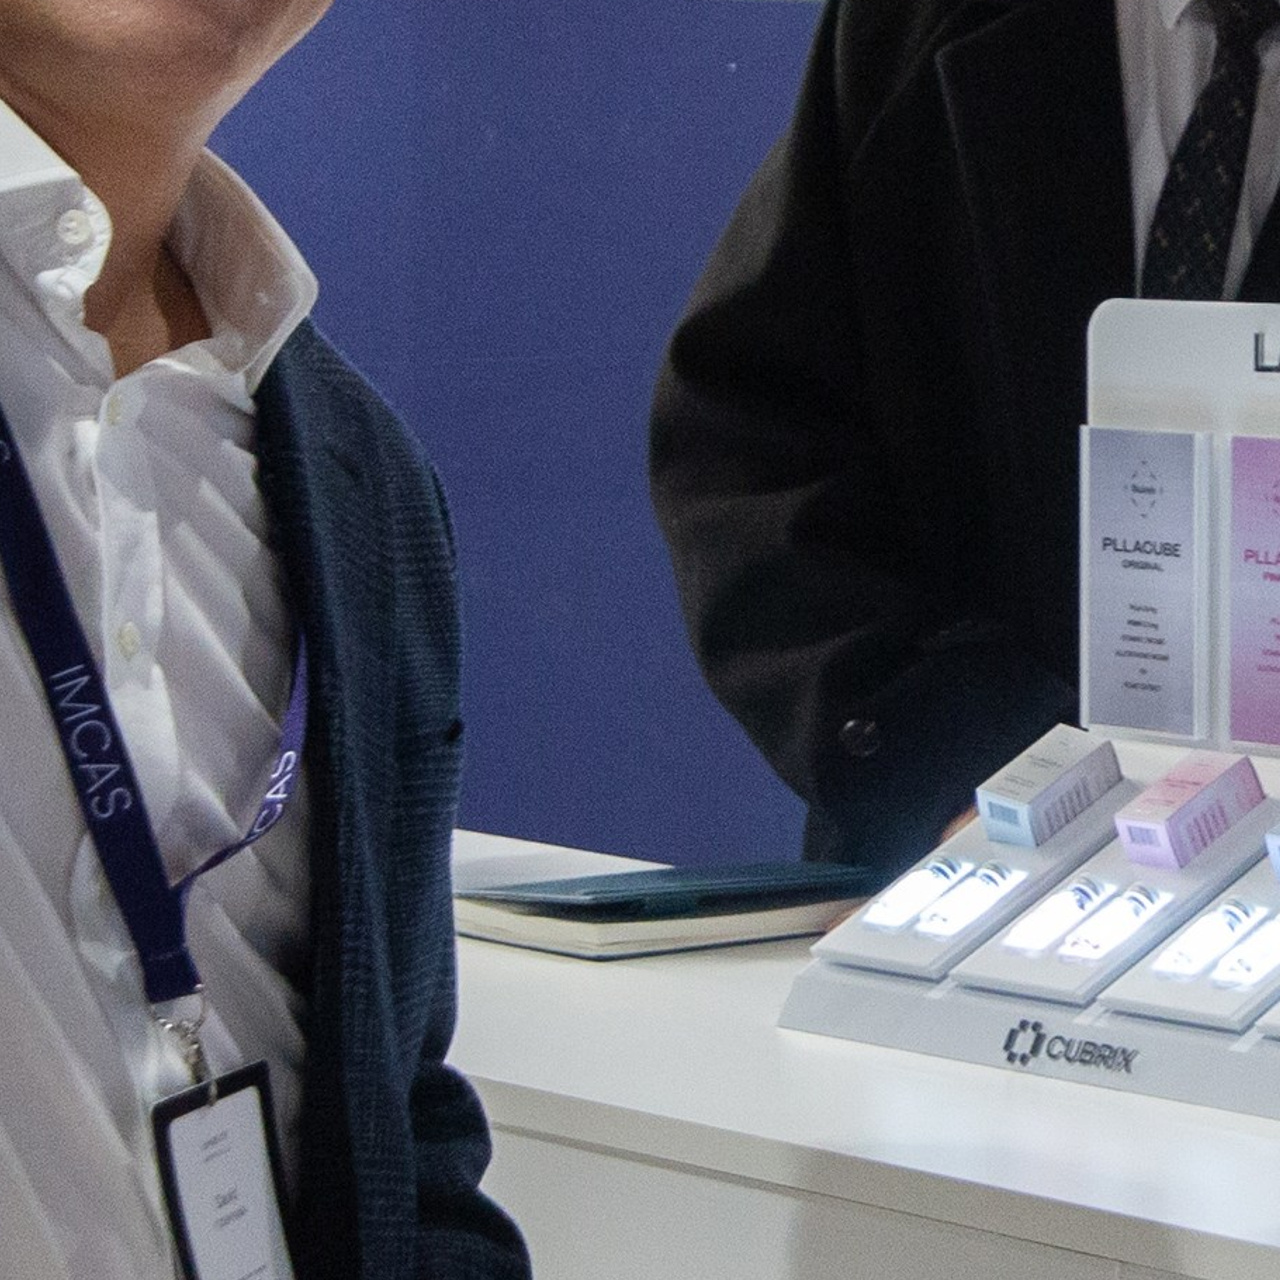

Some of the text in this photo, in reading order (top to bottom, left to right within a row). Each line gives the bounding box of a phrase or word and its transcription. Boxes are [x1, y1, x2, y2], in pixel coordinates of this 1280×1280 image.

[1102, 537, 1182, 559] PLLACUBE
[49, 663, 133, 820] IMCAS
[1045, 1035, 1140, 1074] CUBRIX
